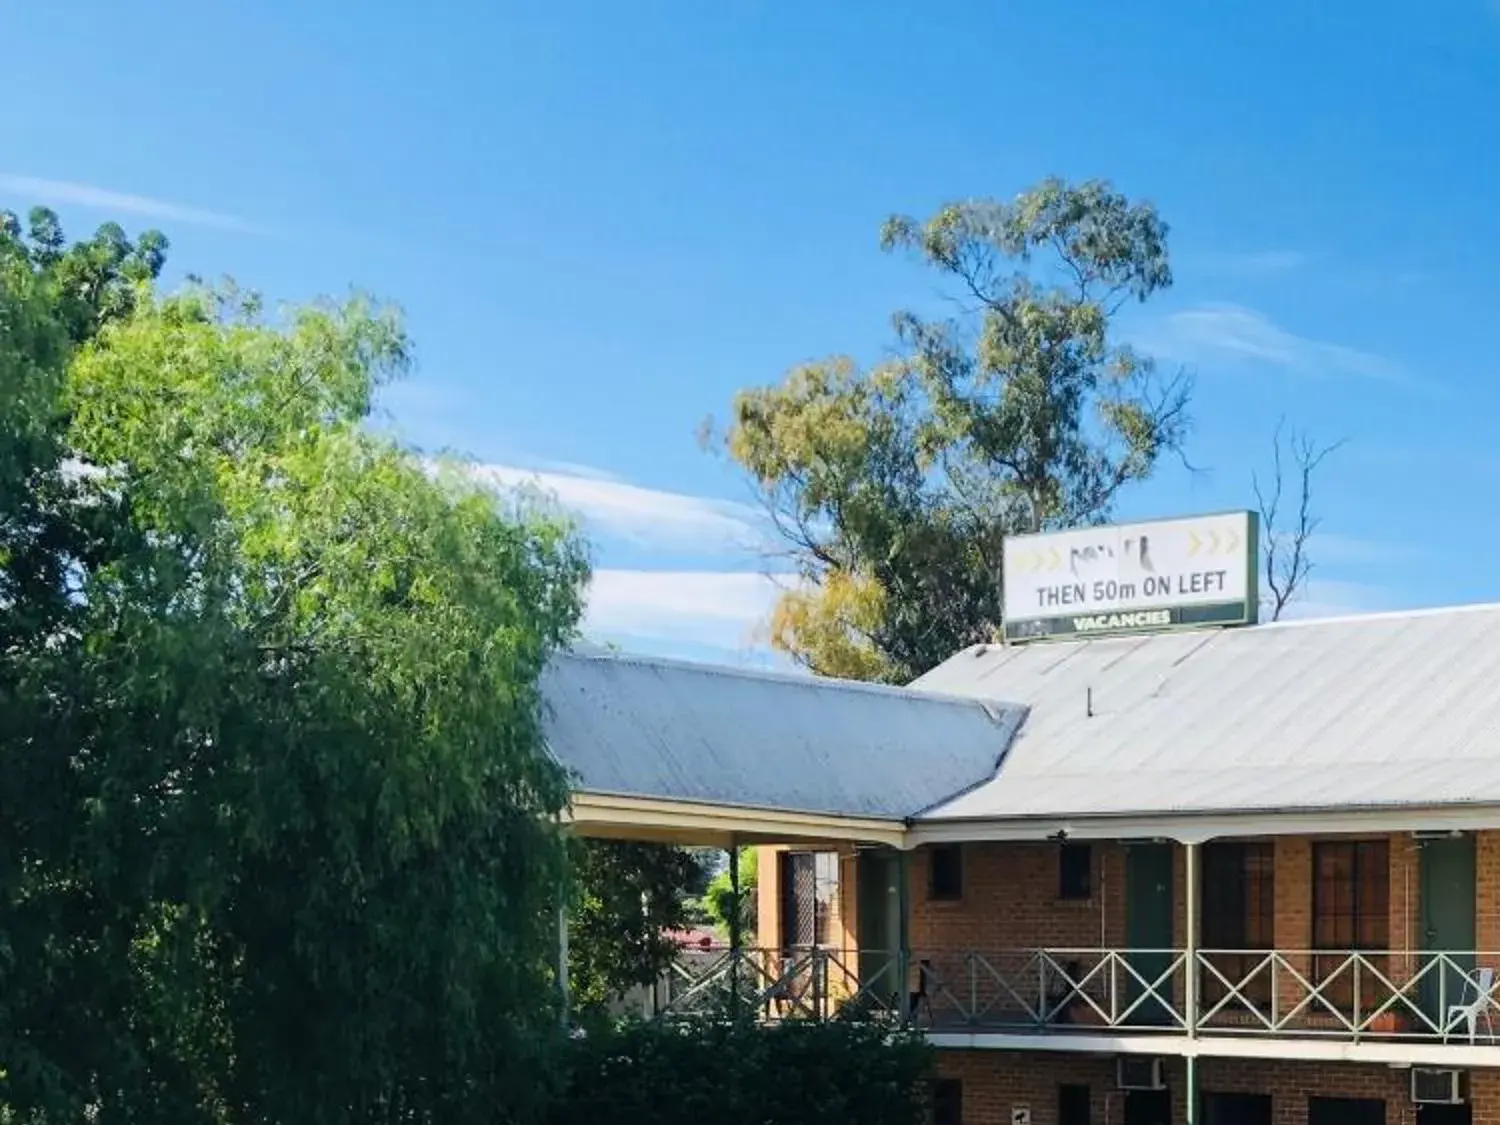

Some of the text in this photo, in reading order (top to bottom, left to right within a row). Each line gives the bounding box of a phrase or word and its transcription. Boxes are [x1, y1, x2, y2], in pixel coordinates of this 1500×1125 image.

[1037, 570, 1227, 607] THEN 50m ON LEFT
[1074, 610, 1171, 631] VACANCIES
